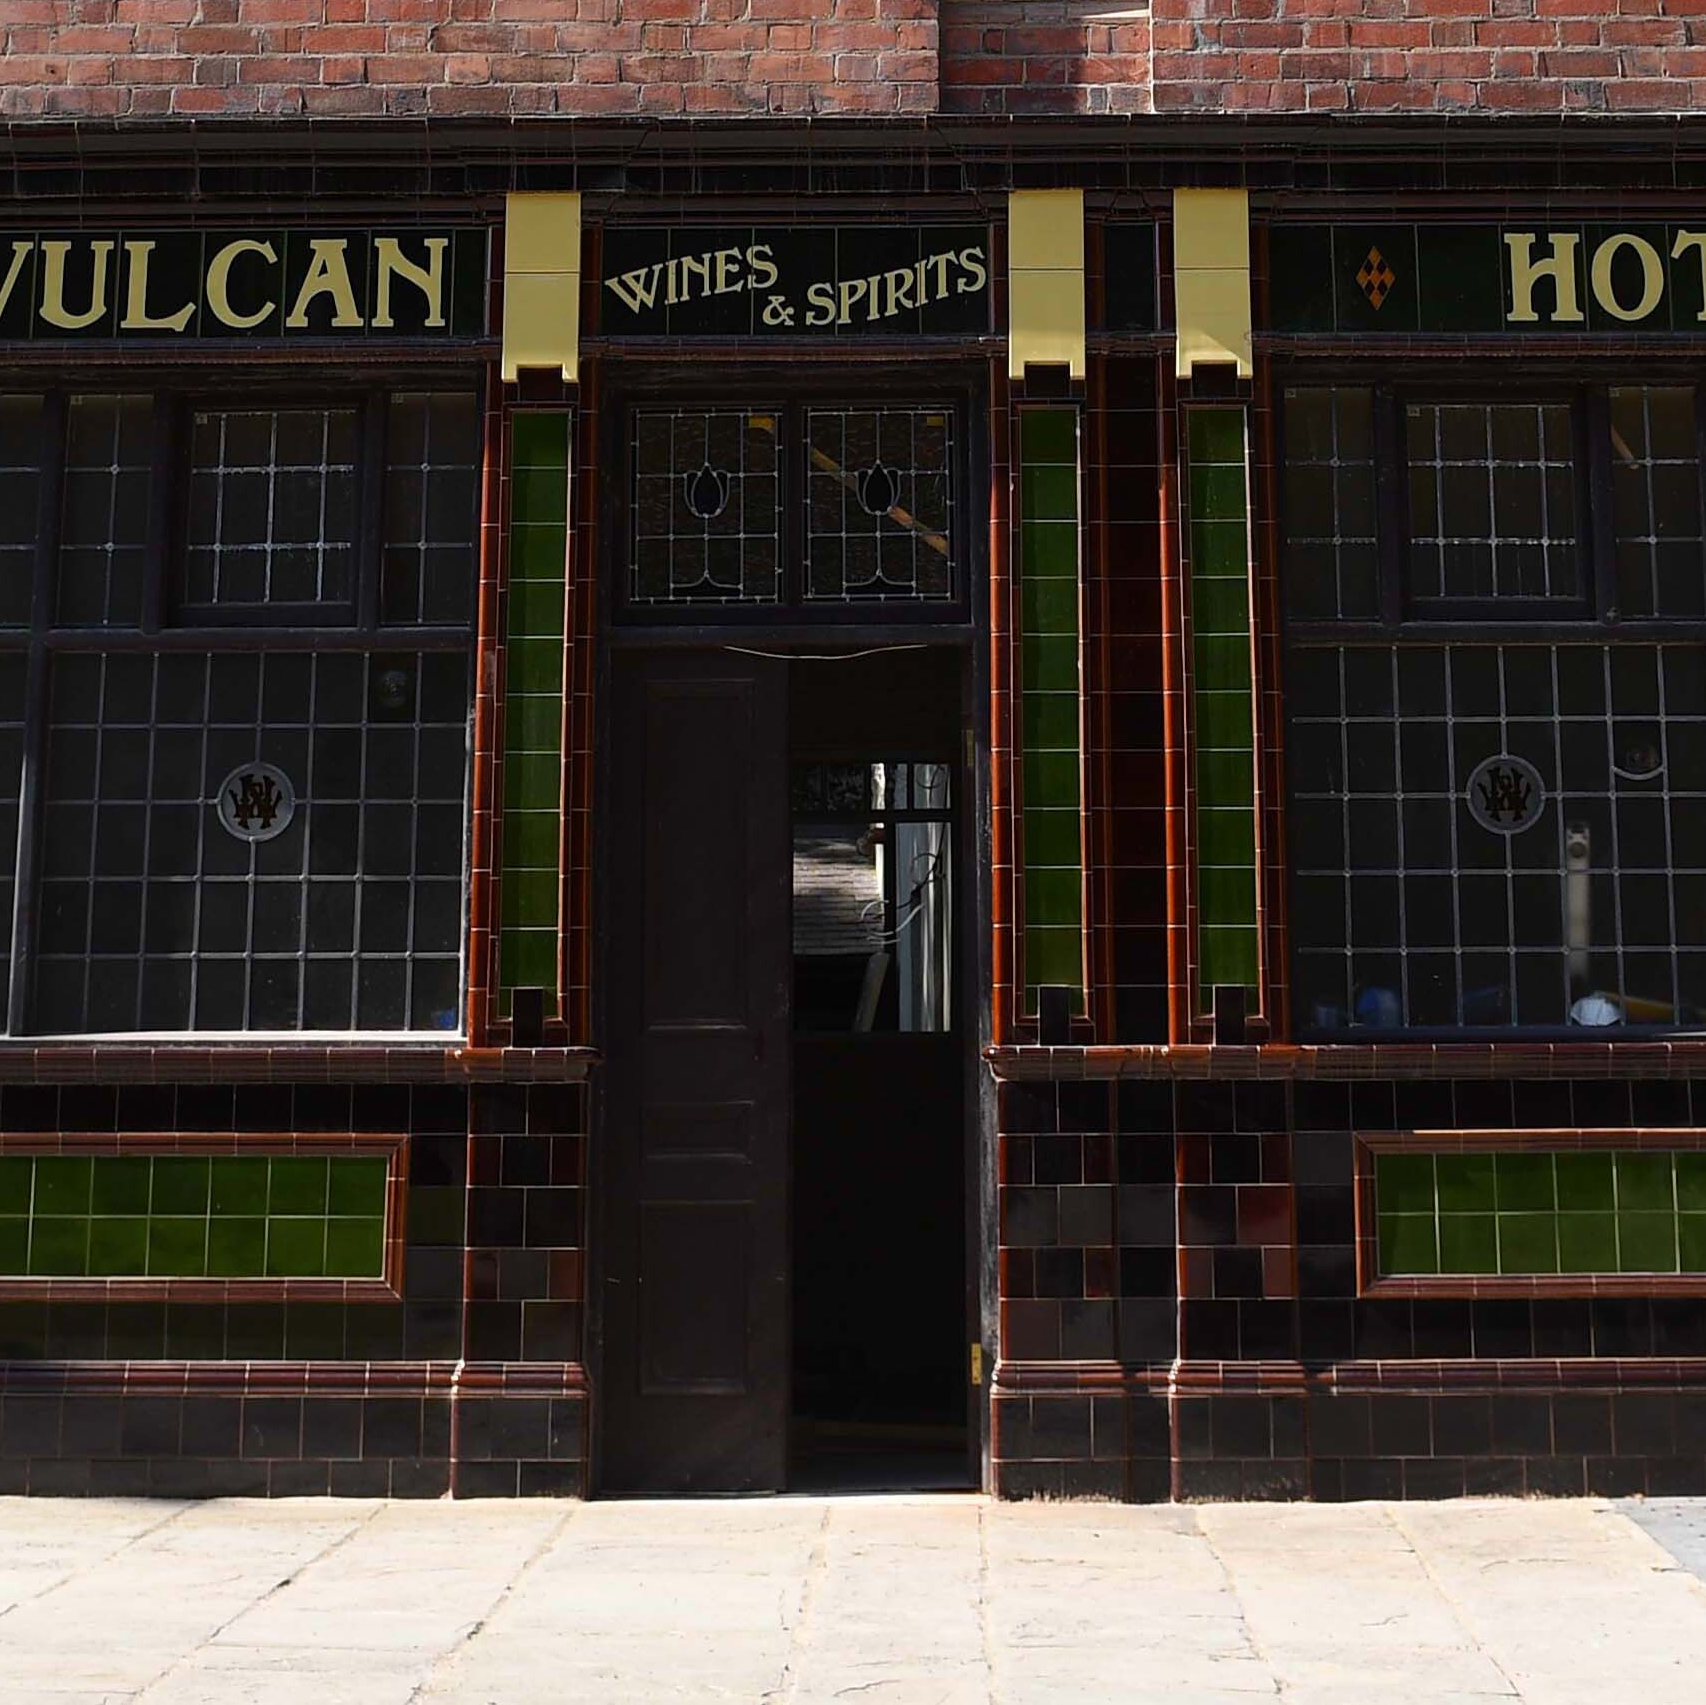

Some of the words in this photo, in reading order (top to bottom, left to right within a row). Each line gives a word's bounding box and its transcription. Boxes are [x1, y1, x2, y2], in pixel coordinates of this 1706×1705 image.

[604, 244, 778, 315] WINES
[762, 295, 795, 326] &
[805, 245, 987, 326] SPIRITS
